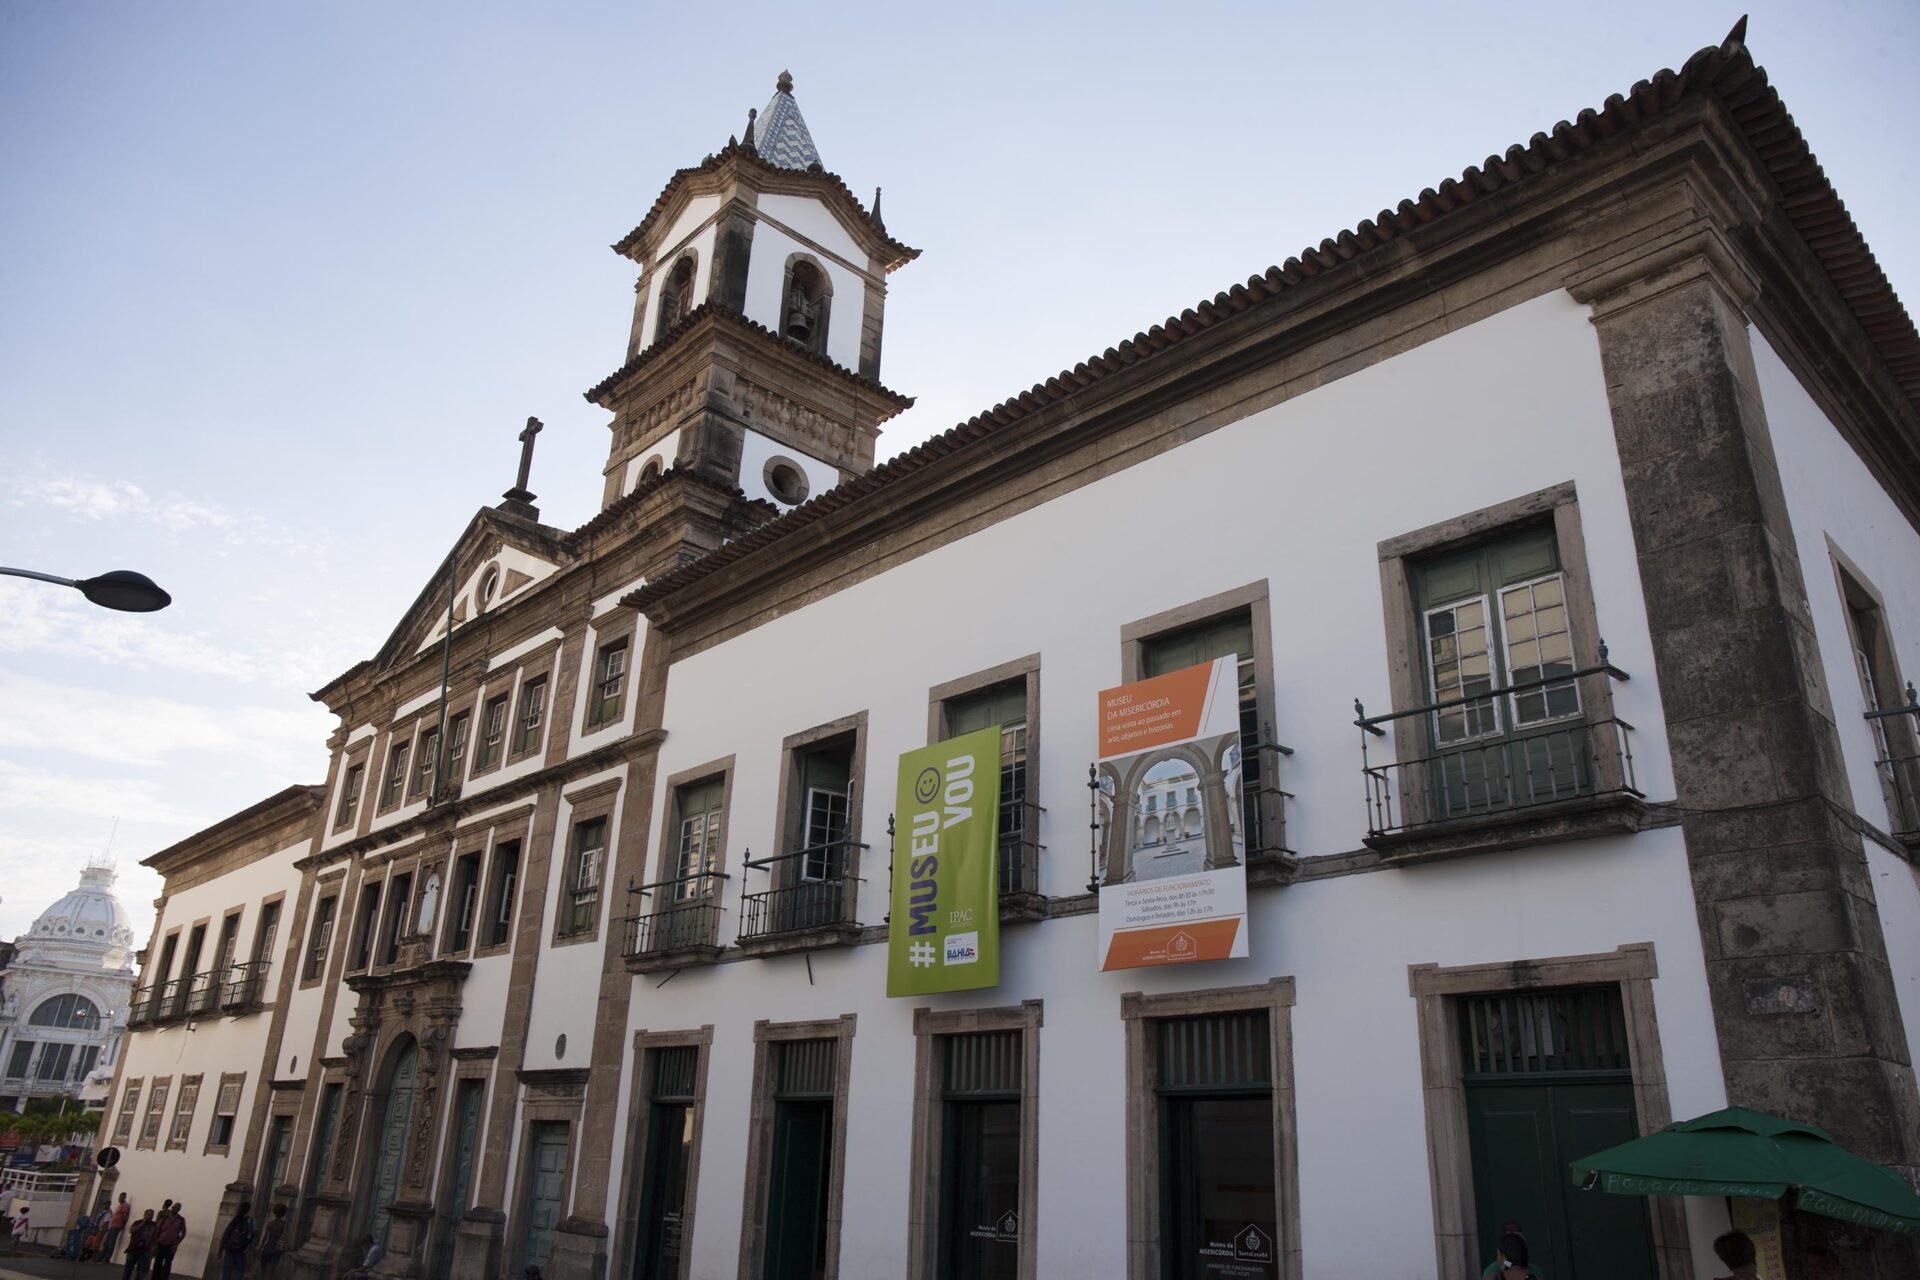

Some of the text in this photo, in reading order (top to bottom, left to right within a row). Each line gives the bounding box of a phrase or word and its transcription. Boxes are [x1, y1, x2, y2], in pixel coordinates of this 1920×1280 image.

[1106, 695, 1132, 708] MUSEU
[1107, 710, 1118, 721] DA
[1107, 725, 1121, 733] Uma
[1122, 720, 1137, 729] visita
[1145, 711, 1171, 725] passado
[1170, 709, 1182, 718] em
[1120, 730, 1143, 741] objetos
[943, 754, 975, 829] VOU
[1154, 885, 1163, 893] DE
[1162, 878, 1212, 892] FUNCIONAMENTO
[1198, 888, 1214, 897] 17h30
[950, 908, 973, 924] IPAC
[947, 947, 971, 959] BAHIA
[1238, 1250, 1268, 1258] SantaCasaBA
